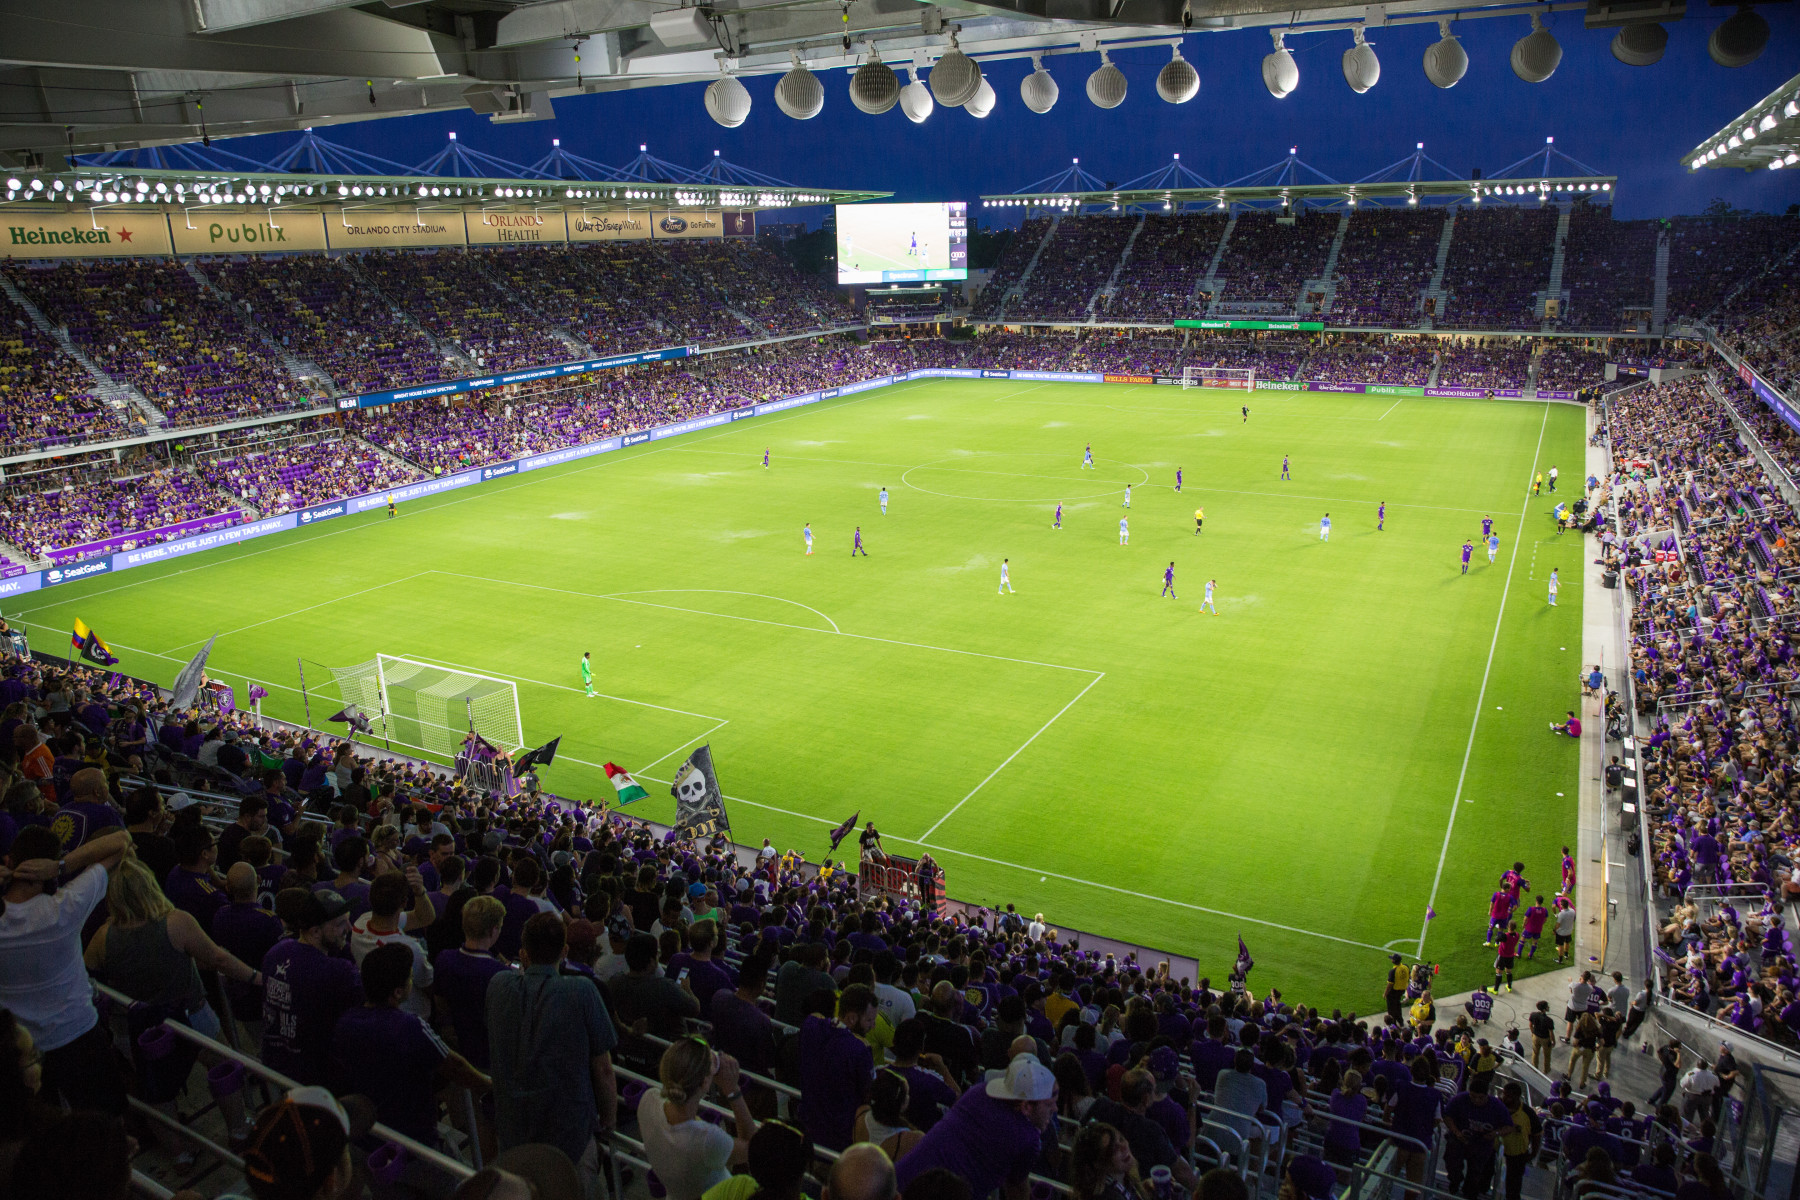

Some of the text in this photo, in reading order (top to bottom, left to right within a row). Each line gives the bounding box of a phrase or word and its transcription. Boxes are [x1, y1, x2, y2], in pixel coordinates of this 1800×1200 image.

[489, 214, 543, 227] ORLANDO
[8, 226, 112, 244] Heineken
[209, 222, 286, 243] Publix
[347, 225, 447, 235] ORLANDO CITY STADIUM
[497, 229, 540, 241] HEALTH
[1104, 375, 1128, 383] WELLS
[1172, 378, 1198, 386] adidas
[436, 385, 457, 393] SPECTRUM
[1255, 381, 1299, 390] Heineken
[339, 399, 357, 408] 46:04
[548, 453, 565, 462] YOU'RE
[492, 464, 516, 476] SeatGeek
[357, 500, 367, 508] BE
[367, 496, 386, 506] HERE.
[408, 487, 421, 496] JUST
[428, 483, 440, 491] FEW
[440, 480, 454, 488] TAPS
[454, 476, 471, 485] AWAY.
[312, 505, 344, 519] SeatGeek
[128, 520, 284, 564] BE HERE. YOU'RE JUST A FEW TAPS AWAY.
[64, 561, 108, 578] SeatGeek
[1474, 999, 1491, 1009] 003
